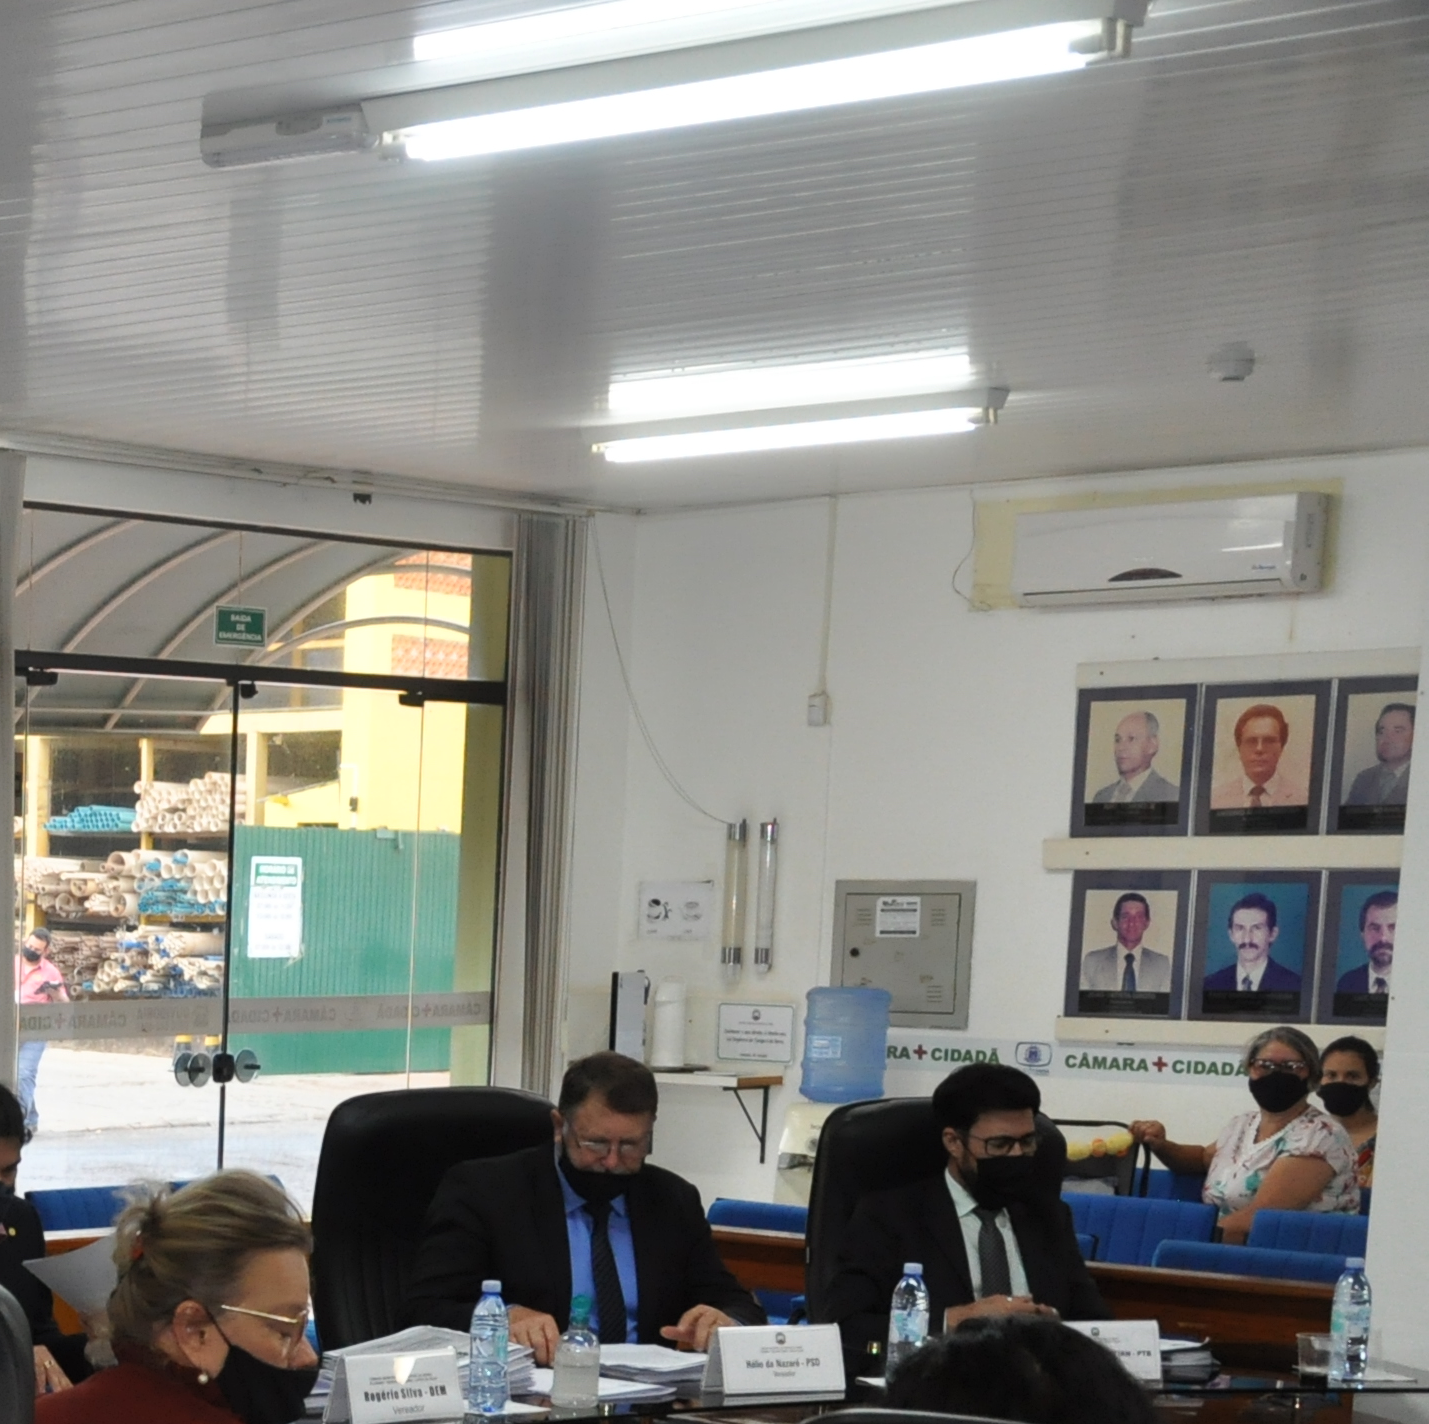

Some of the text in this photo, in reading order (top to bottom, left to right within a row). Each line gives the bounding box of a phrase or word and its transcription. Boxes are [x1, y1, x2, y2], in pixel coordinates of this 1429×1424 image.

[1064, 1052, 1149, 1073] CÂMARA
[363, 1389, 400, 1403] Rogério
[401, 1388, 423, 1399] Silva
[429, 1384, 448, 1398] DEM
